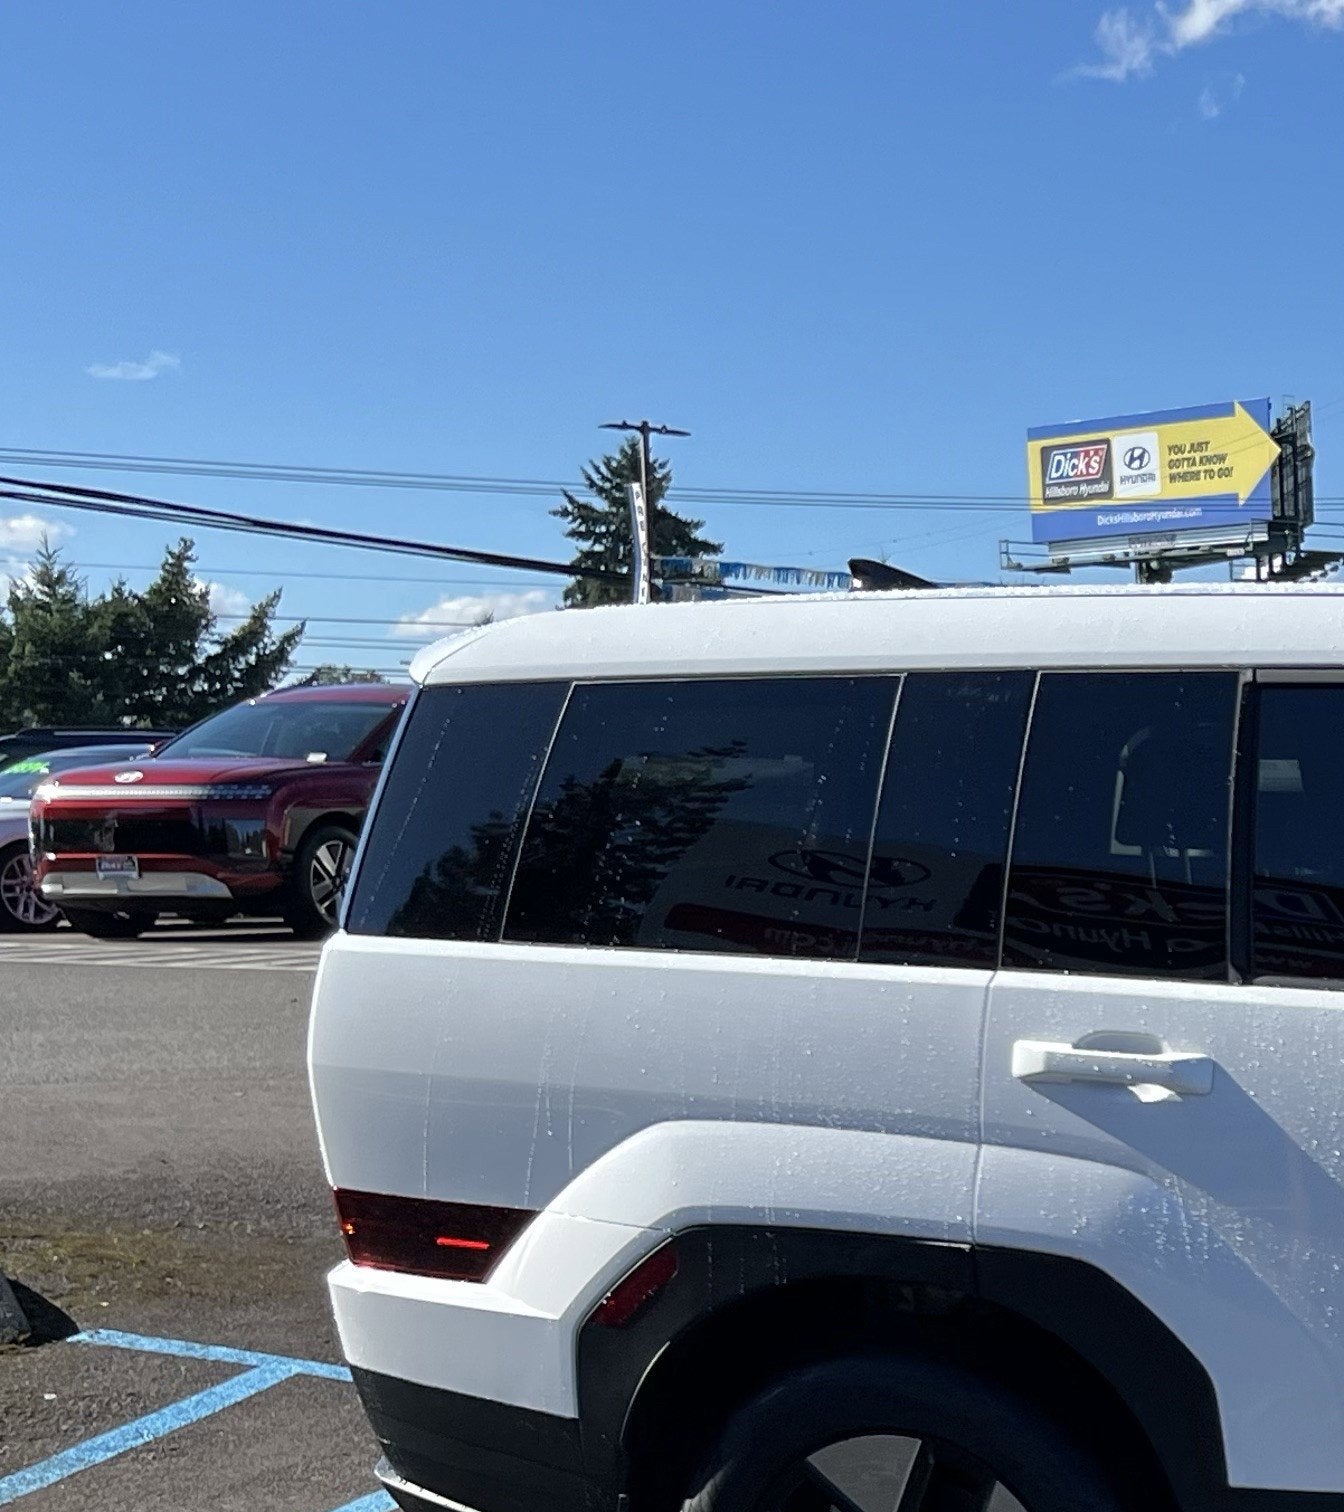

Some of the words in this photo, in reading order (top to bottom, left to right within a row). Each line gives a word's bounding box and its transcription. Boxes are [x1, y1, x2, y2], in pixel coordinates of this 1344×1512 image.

[1167, 443, 1186, 456] YOU
[1187, 441, 1210, 454] JUST
[1050, 450, 1101, 479] Dick's
[1168, 456, 1197, 469] GOTTA
[1199, 453, 1228, 466] KNOW
[1120, 473, 1156, 485] HYUNDAI
[1169, 470, 1201, 483] WHERE
[1203, 468, 1215, 480] TO
[1045, 484, 1079, 498] Hillsboro
[1079, 481, 1110, 497] Hyundai
